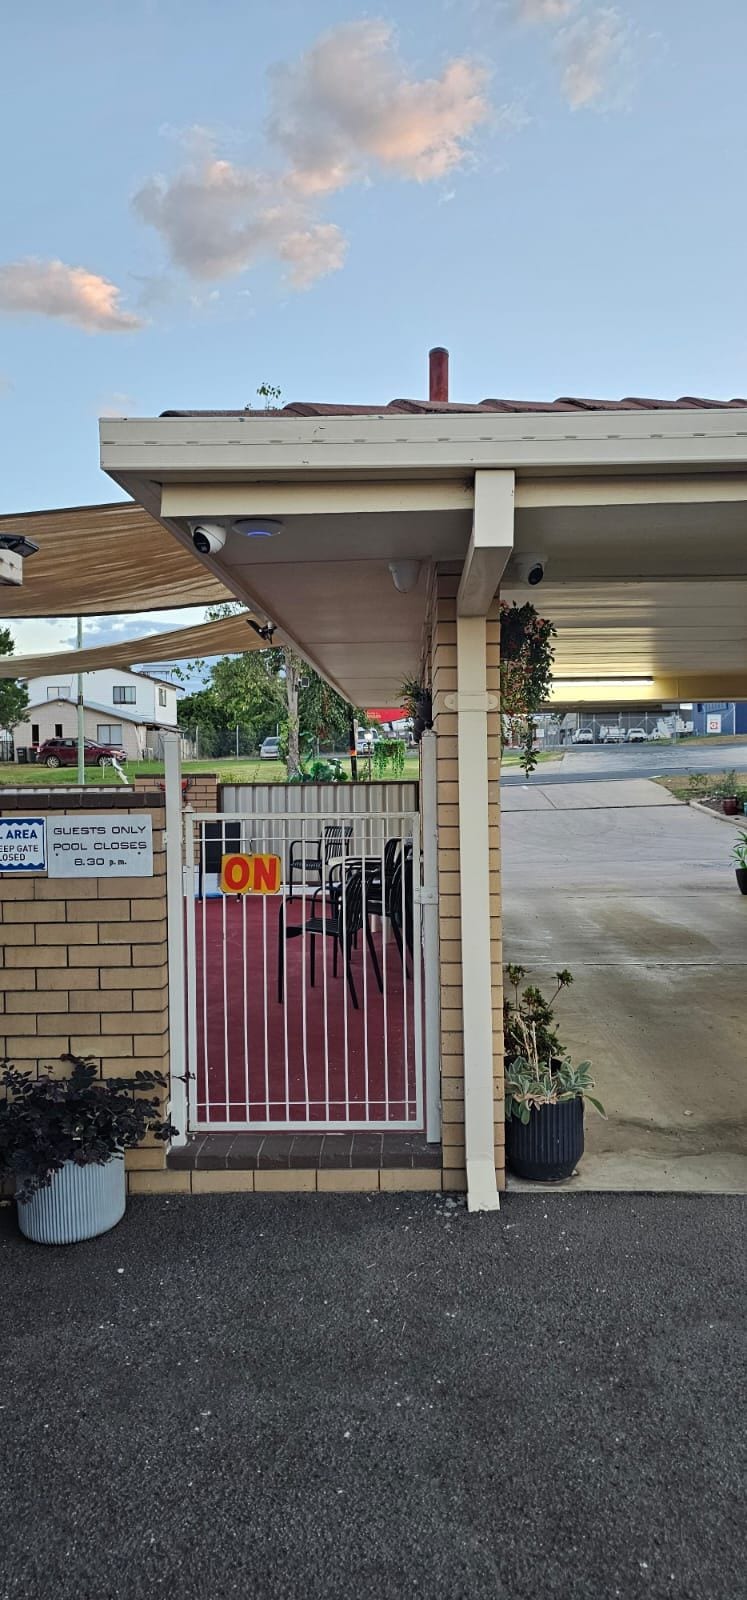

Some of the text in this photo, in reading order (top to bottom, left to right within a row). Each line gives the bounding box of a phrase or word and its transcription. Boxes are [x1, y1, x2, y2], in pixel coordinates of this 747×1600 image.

[6, 829, 38, 839] AREA
[53, 826, 146, 835] GUESTS ONLY
[16, 844, 39, 853] GATE
[53, 842, 147, 851] POOL CLOSES
[74, 858, 105, 866] 8.30
[224, 856, 277, 890] ON
